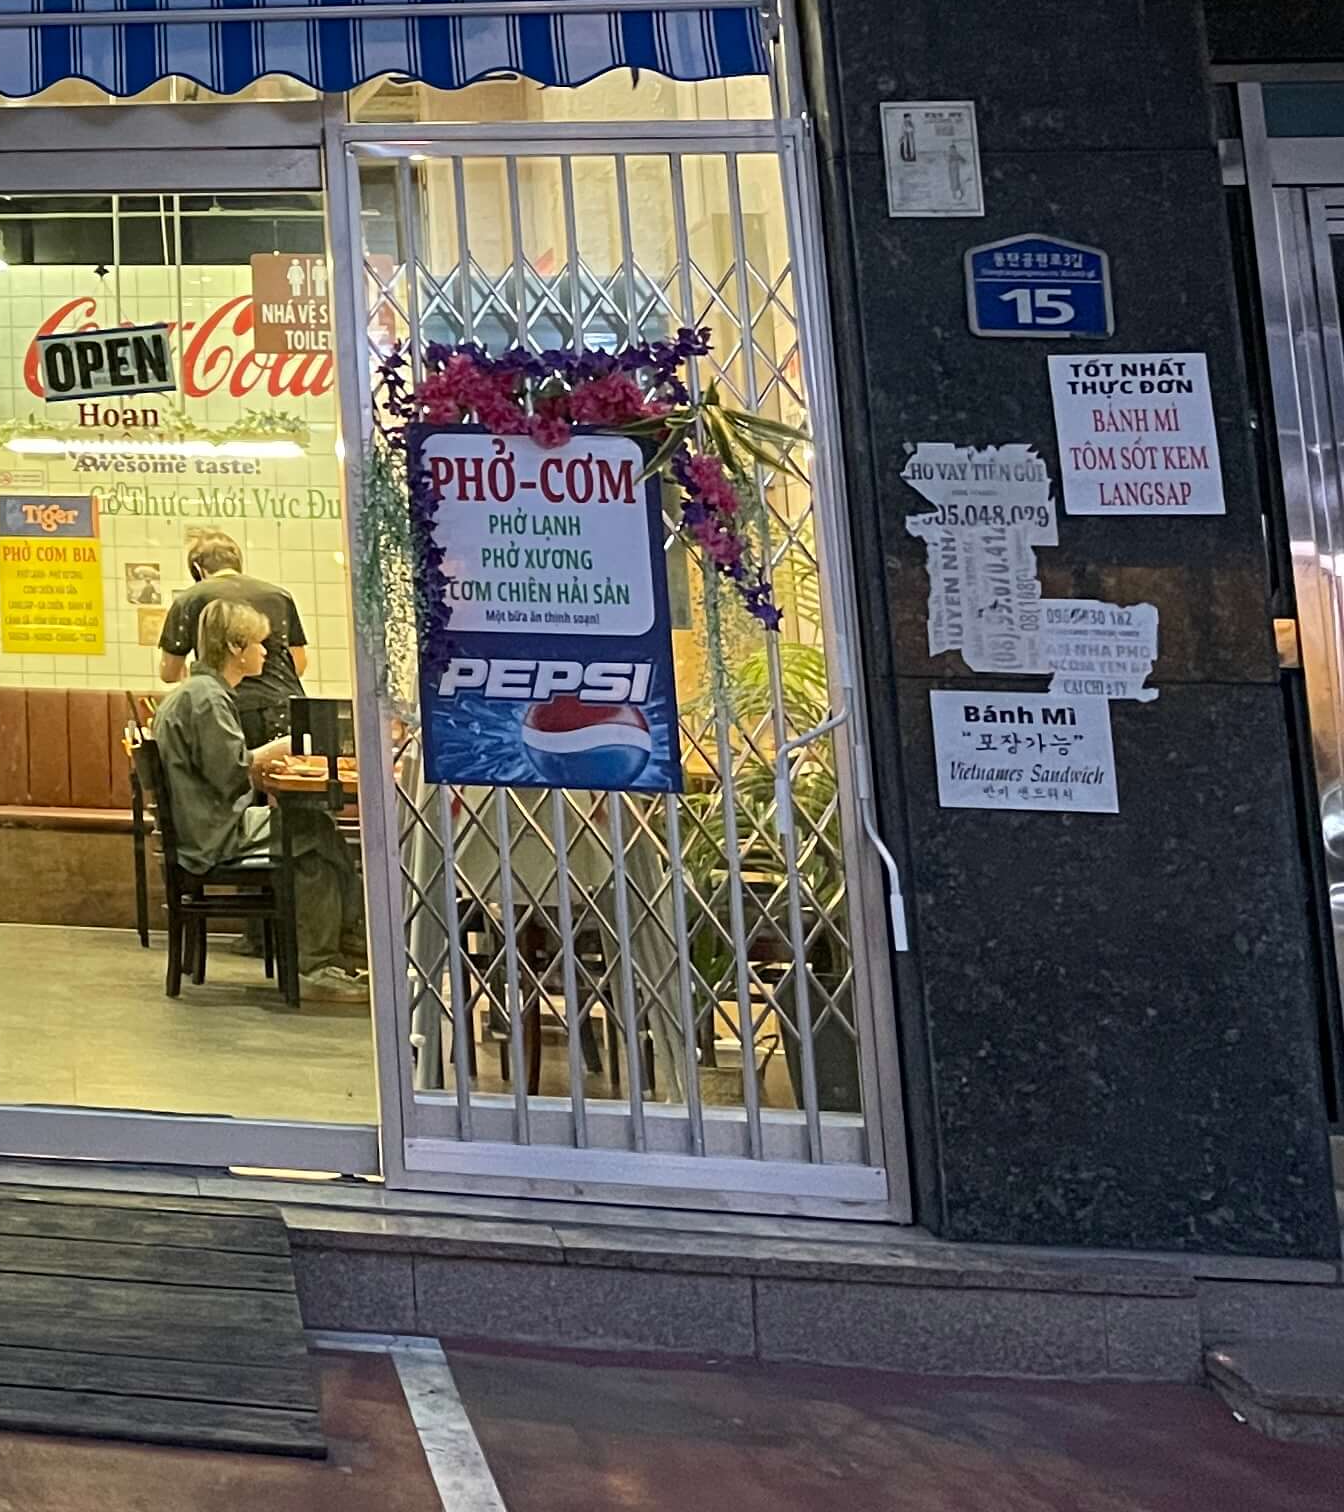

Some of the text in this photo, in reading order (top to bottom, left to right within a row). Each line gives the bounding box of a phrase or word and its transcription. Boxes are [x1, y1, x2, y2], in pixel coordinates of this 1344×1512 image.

[999, 289, 1075, 325] 15
[44, 334, 169, 392] OPEN
[1069, 358, 1186, 377] TỐT NHẤT
[1067, 379, 1193, 399] THỰC ĐƠN
[78, 403, 160, 427] Hoan
[1070, 440, 1116, 470] TÔM
[1162, 446, 1209, 469] KEM
[429, 439, 636, 504] PHỞ-CƠM
[908, 463, 934, 480] HO
[935, 463, 967, 481] VAY
[1099, 482, 1191, 506] LANGSAP
[21, 504, 79, 532] Tiger
[489, 507, 581, 541] PHỞ LẠNH
[920, 504, 1049, 527] 05.048.029
[481, 541, 593, 570] PHỞ XƯƠNG
[450, 576, 630, 605] CƠM CHIÊN HẢI SẢN
[438, 659, 654, 703] PEPSI
[964, 705, 1077, 726] Bánh Mì
[1031, 763, 1104, 785] Sandwich
